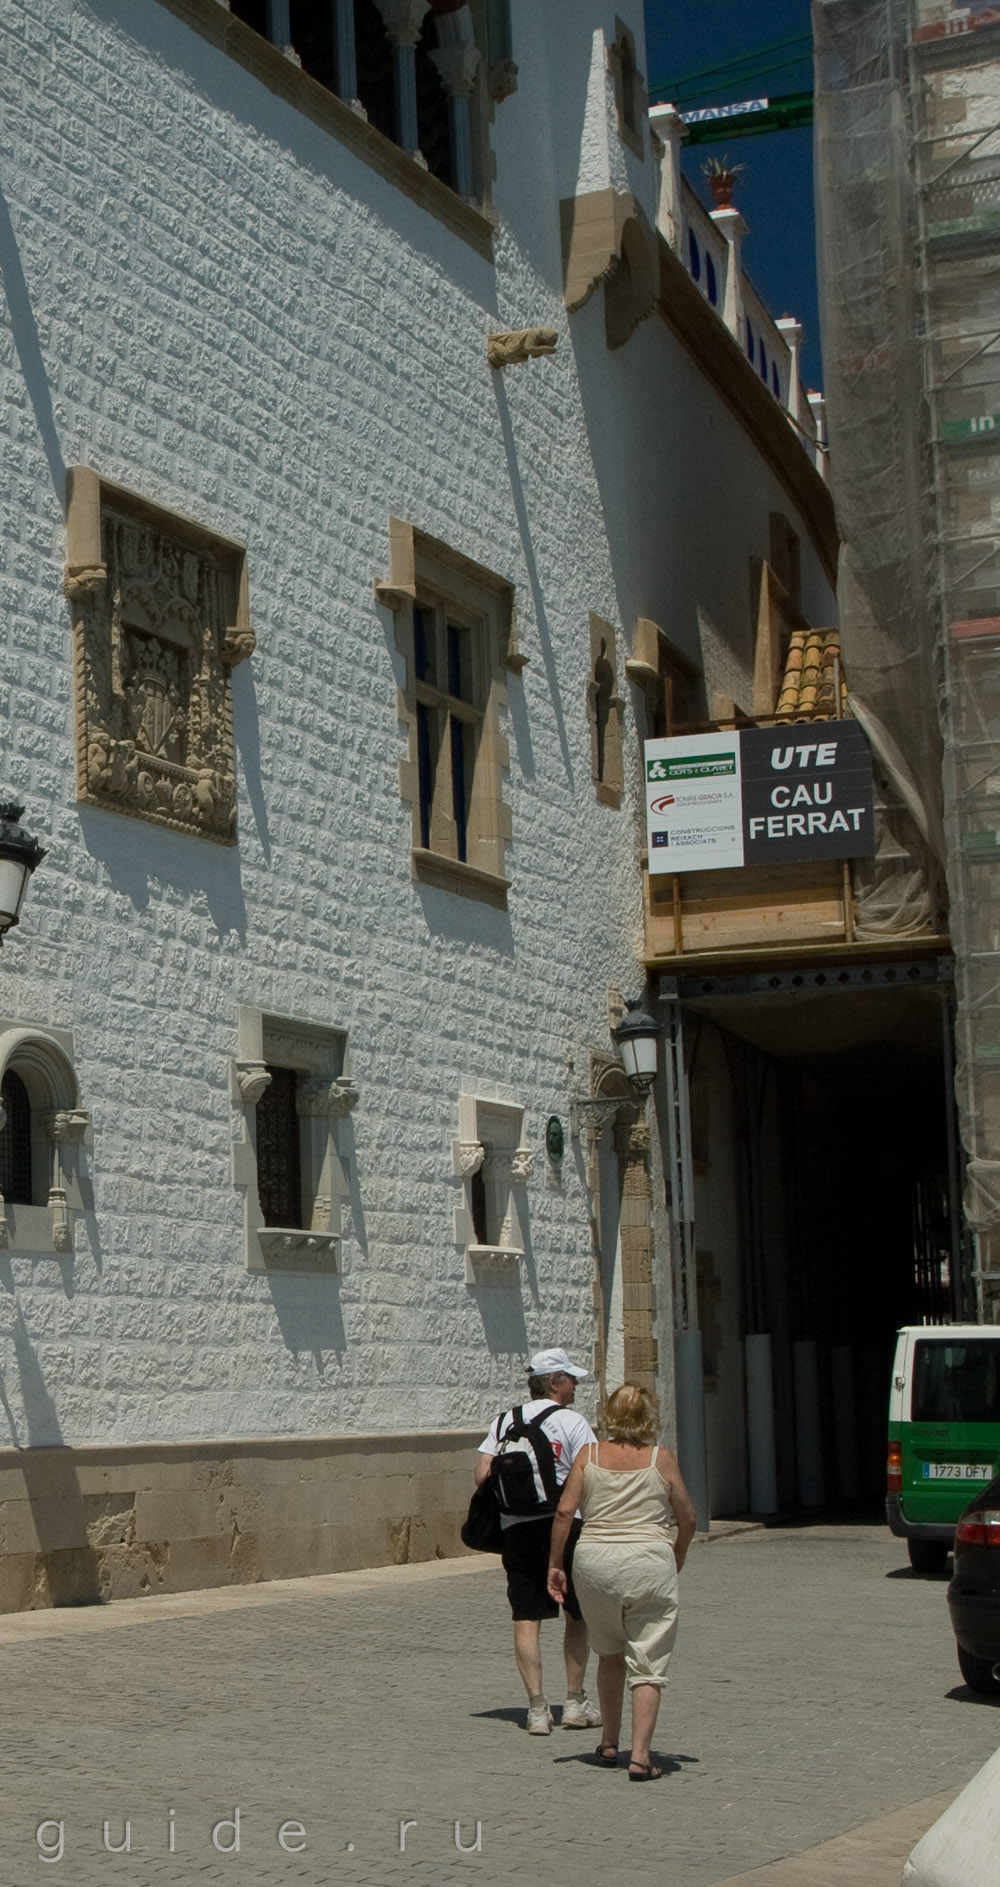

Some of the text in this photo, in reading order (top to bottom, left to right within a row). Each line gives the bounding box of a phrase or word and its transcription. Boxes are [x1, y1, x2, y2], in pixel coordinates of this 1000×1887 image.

[680, 101, 764, 123] MANSA
[770, 742, 838, 770] UTE
[770, 782, 832, 808] CAU
[670, 825, 736, 835] CONSTRUCCIONS
[749, 808, 866, 840] FERRAT
[934, 1465, 961, 1478] 1773
